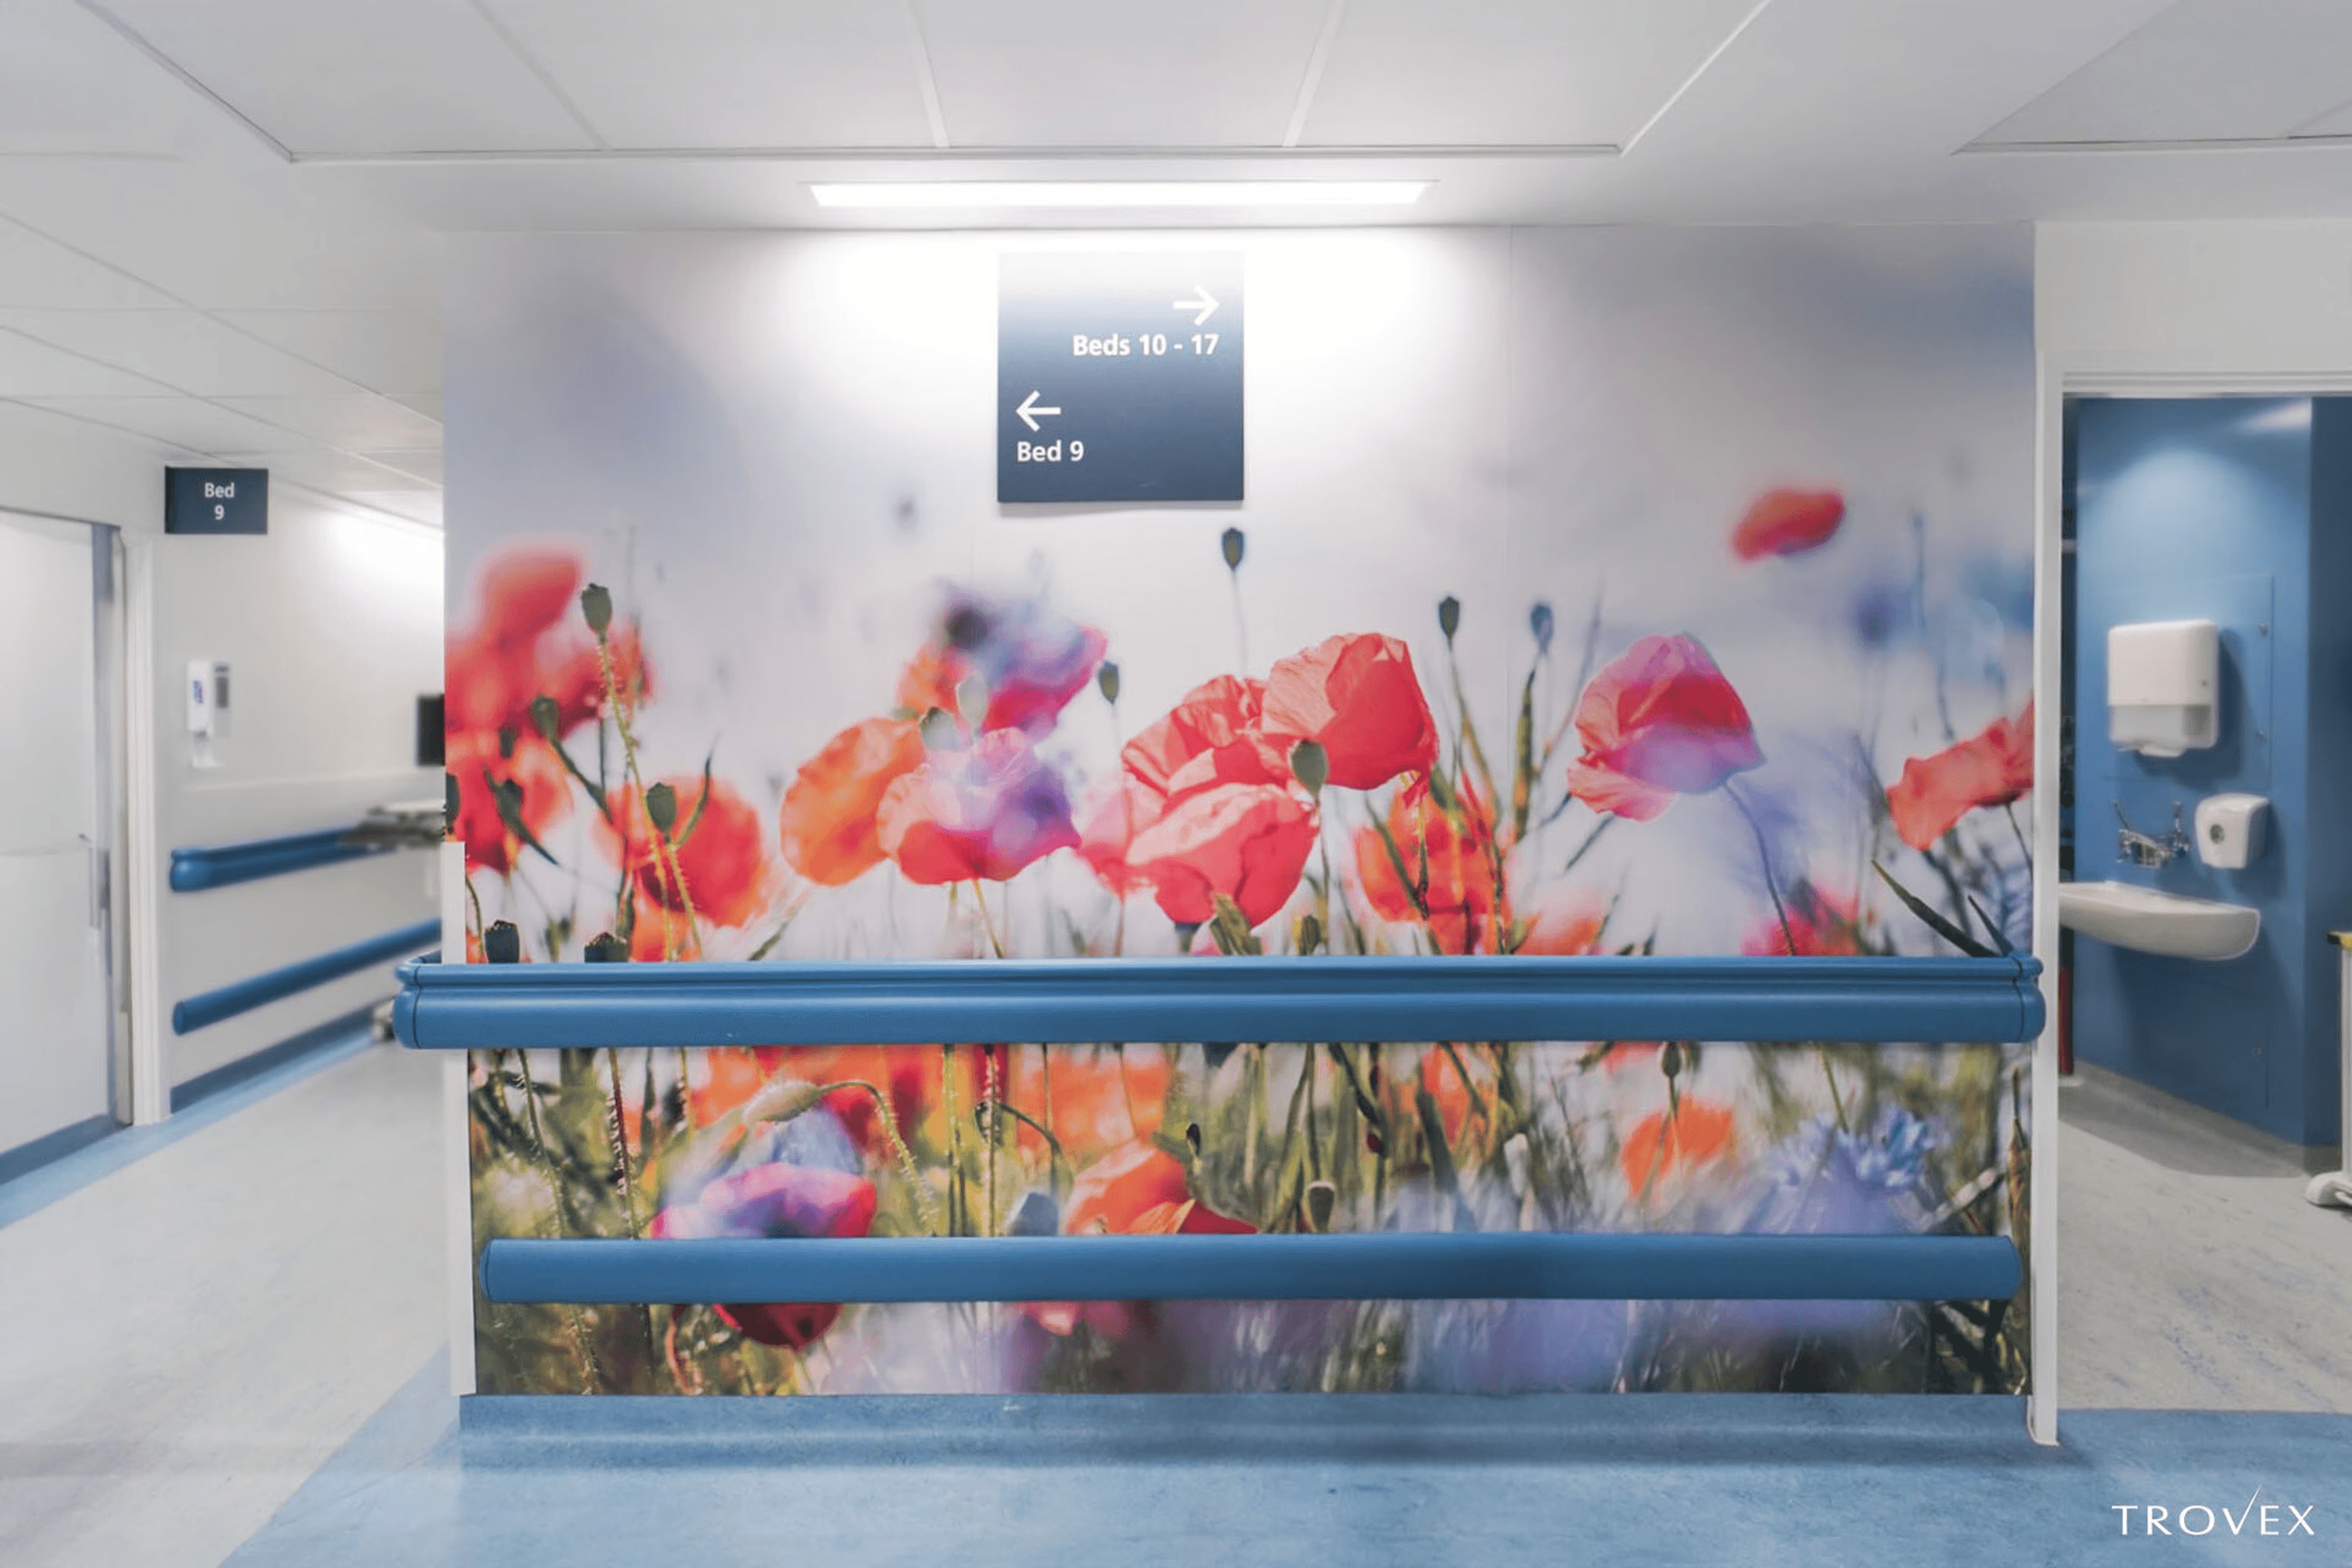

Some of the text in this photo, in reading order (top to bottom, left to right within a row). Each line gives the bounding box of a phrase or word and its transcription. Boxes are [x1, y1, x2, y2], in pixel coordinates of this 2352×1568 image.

[1073, 333, 1131, 356] Beds
[1139, 333, 1167, 355] 10
[1191, 333, 1219, 355] 17
[1017, 440, 1084, 462] Bed 9
[205, 481, 235, 499] Bed
[213, 504, 225, 521] 9
